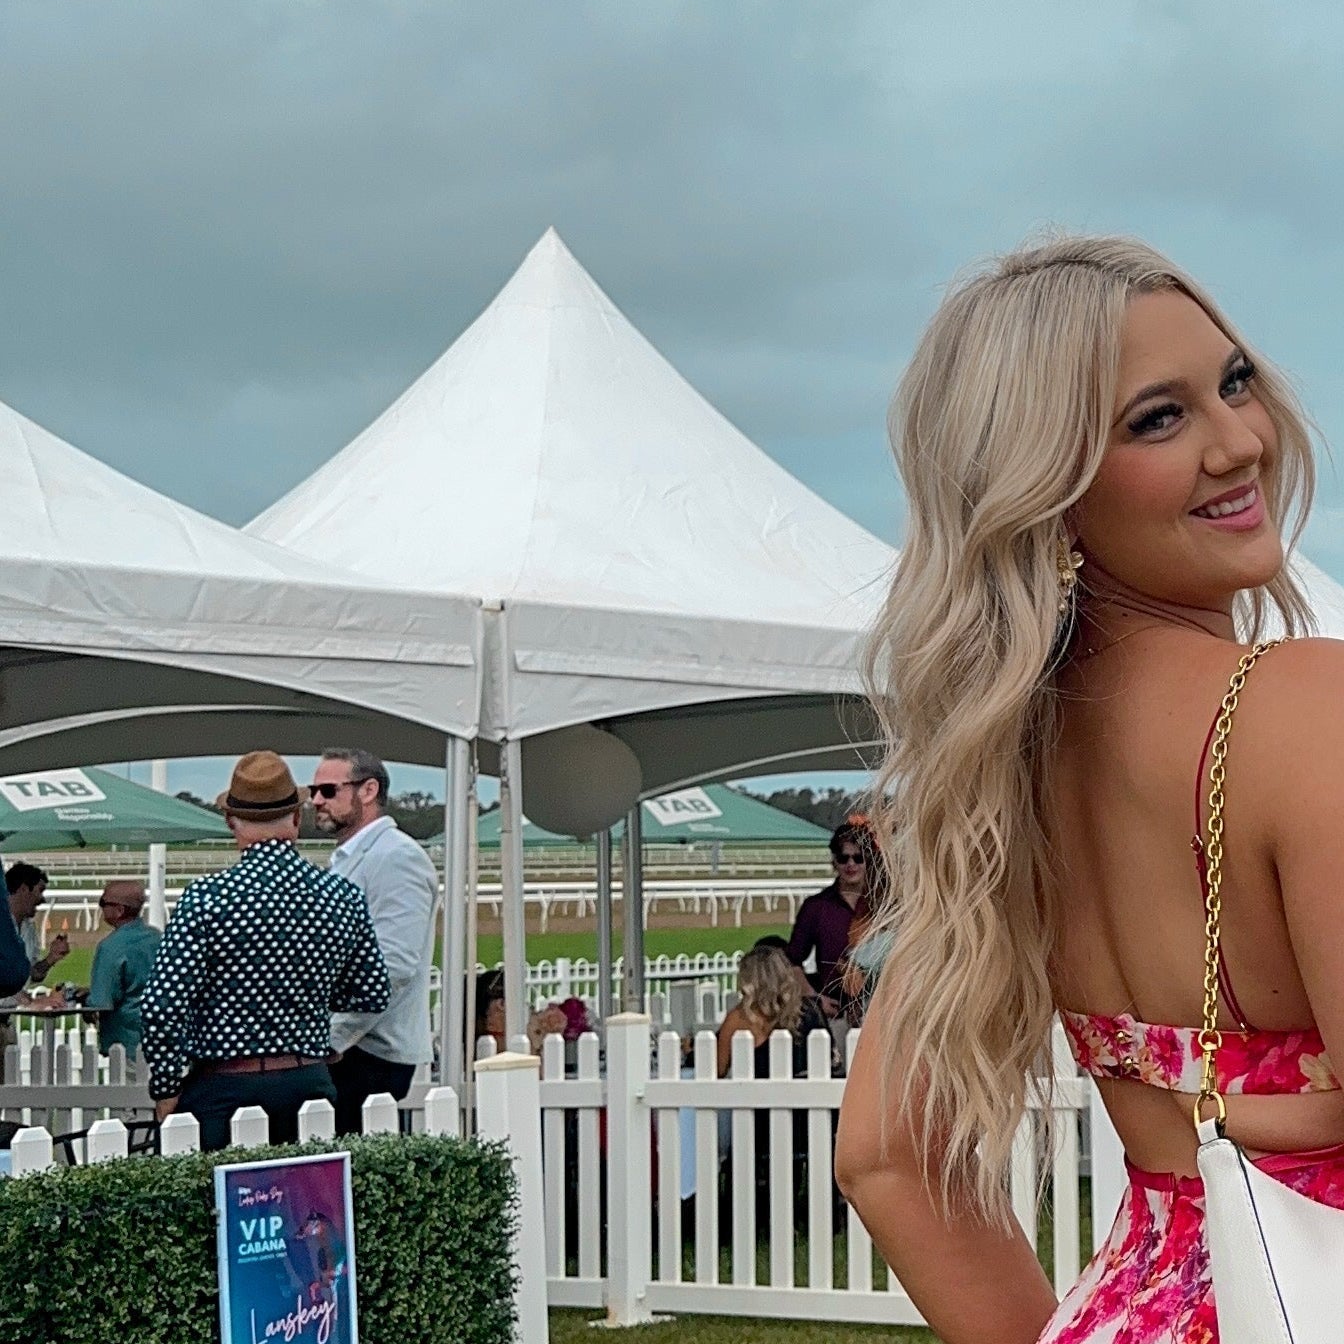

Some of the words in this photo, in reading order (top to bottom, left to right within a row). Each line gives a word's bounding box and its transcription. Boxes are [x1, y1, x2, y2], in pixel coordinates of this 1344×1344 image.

[5, 781, 94, 797] TAB
[656, 798, 713, 813] TAB
[240, 1216, 283, 1241] VIP
[238, 1238, 287, 1256] CABANA
